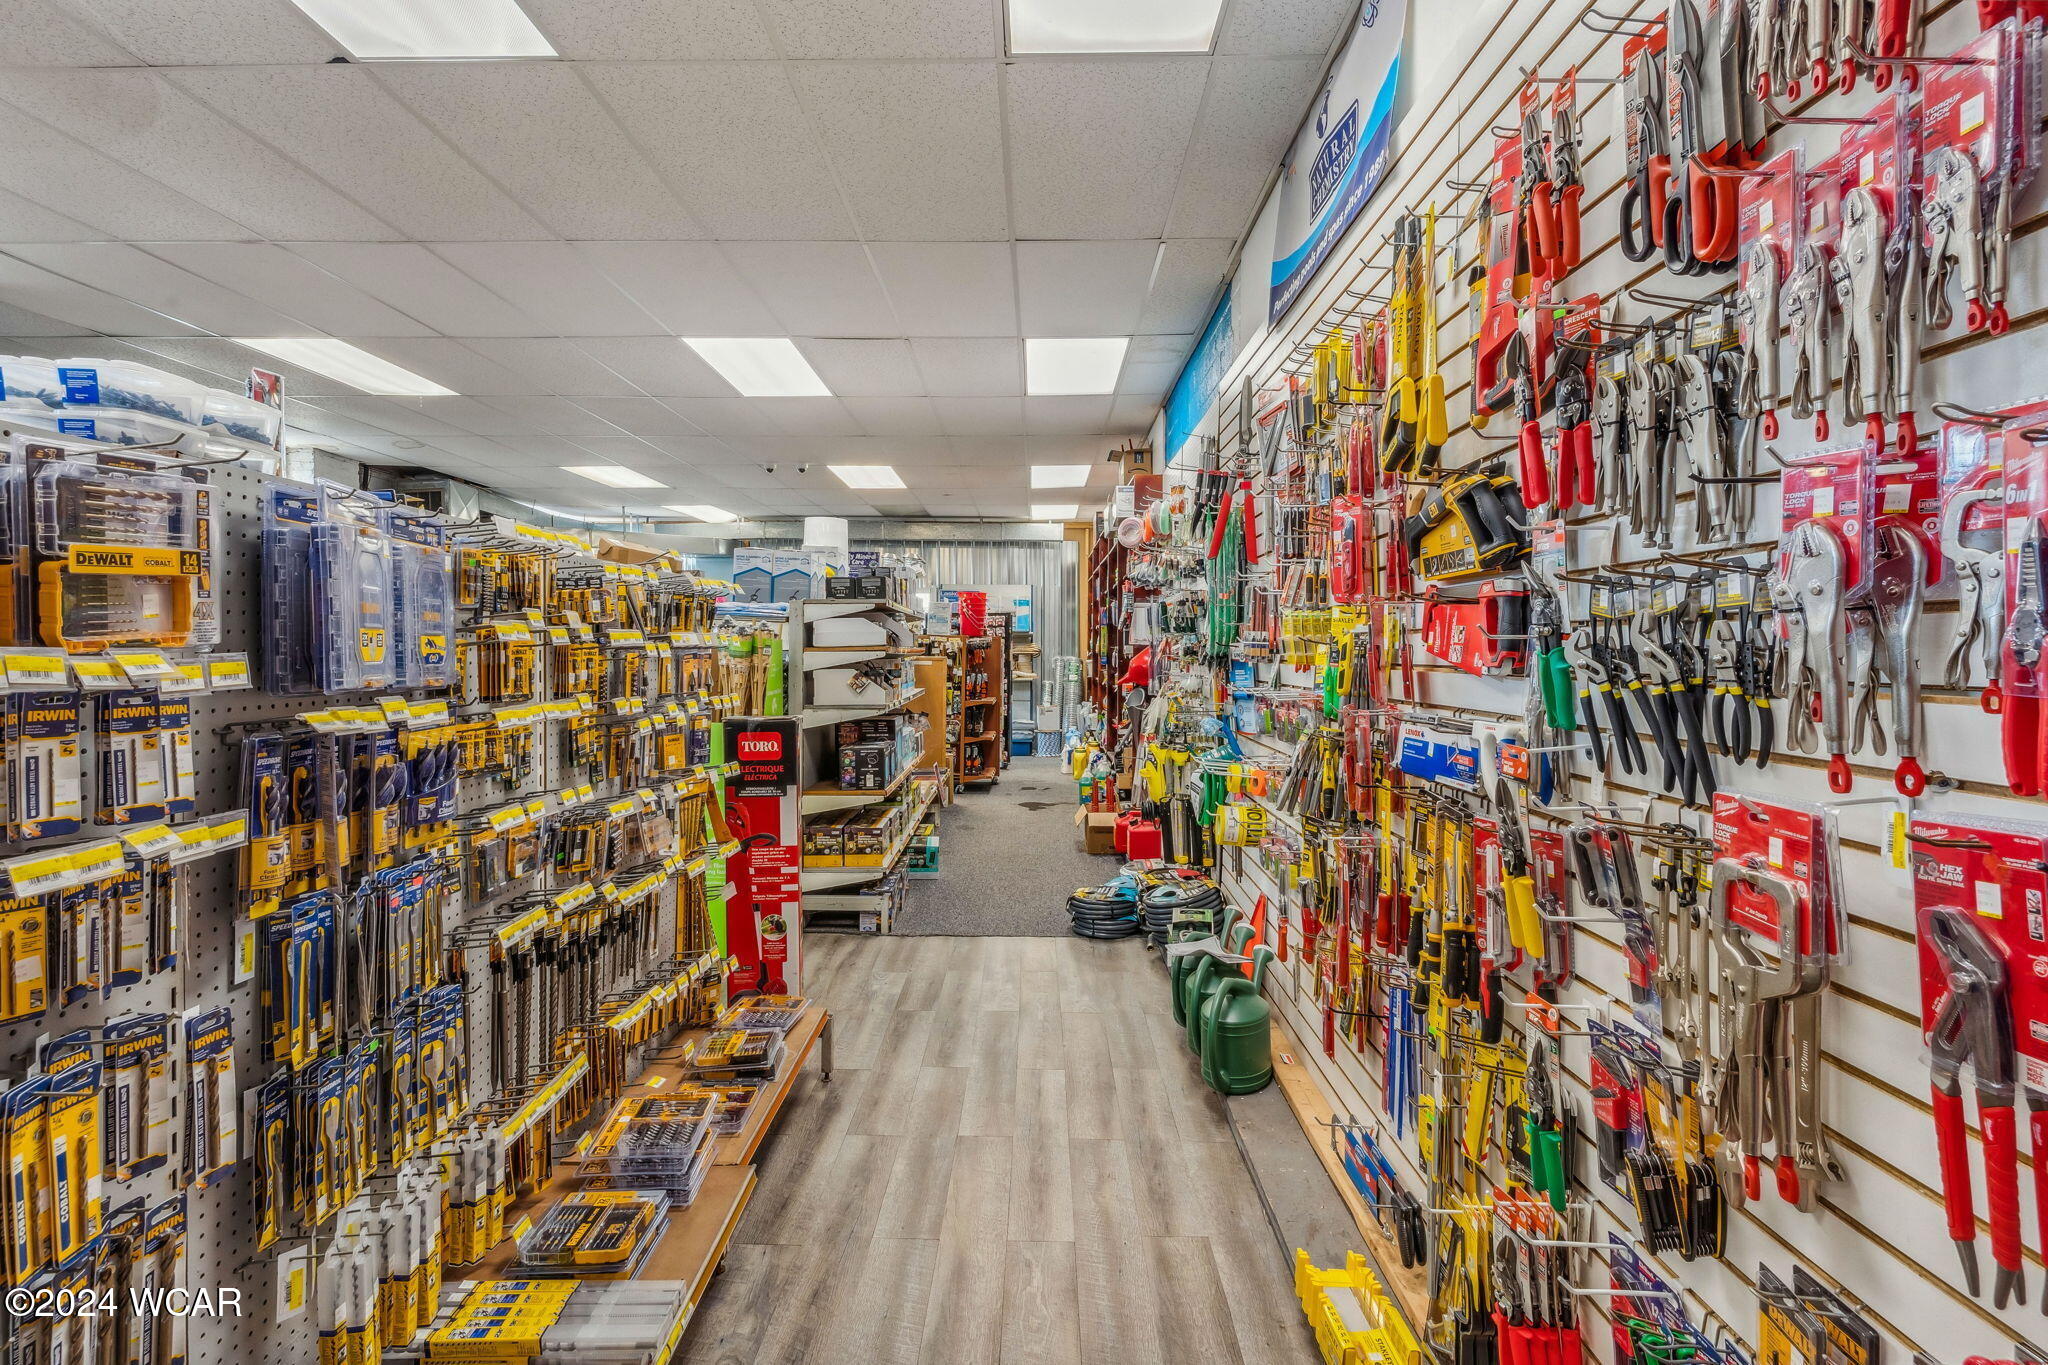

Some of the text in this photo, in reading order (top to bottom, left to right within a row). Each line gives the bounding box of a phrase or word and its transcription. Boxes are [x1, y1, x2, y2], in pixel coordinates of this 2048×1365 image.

[1925, 91, 1963, 115] TORQUE
[1925, 105, 1951, 123] LOCK
[1312, 117, 1357, 194] NATURAL
[1312, 137, 1357, 214] CHEMISTRY
[1273, 275, 1302, 315] Perfecting
[1301, 254, 1317, 282] pools
[1316, 231, 1329, 258] and
[1328, 213, 1345, 239] spas
[1344, 187, 1364, 219] since
[1563, 309, 1599, 327] CRESCENT
[1396, 304, 1405, 354] STANLEY
[1414, 303, 1422, 353] STANLEY
[1784, 498, 1806, 506] LOCK
[75, 552, 198, 568] DEWALT COBALT 14
[193, 602, 215, 620] 4X
[27, 709, 77, 722] IRWIN
[113, 706, 157, 719] IRWIN
[160, 704, 188, 716] RWIN
[1405, 728, 1421, 737] LENOX
[740, 765, 785, 773] LECTRIQUE
[1714, 822, 1739, 834] TORQUE
[1714, 829, 1731, 839] LOCK
[1913, 826, 1949, 837] Milwaukee
[1940, 863, 1963, 875] HEX
[1940, 873, 1964, 882] JAW
[270, 922, 293, 932] SPEED
[117, 1033, 164, 1057] IRWIN
[194, 1027, 230, 1050] IRWIN
[49, 1050, 92, 1075] IRWIN
[58, 1180, 68, 1223] COBALT
[17, 1200, 27, 1245] COBALT
[146, 1213, 185, 1242] IRWIN
